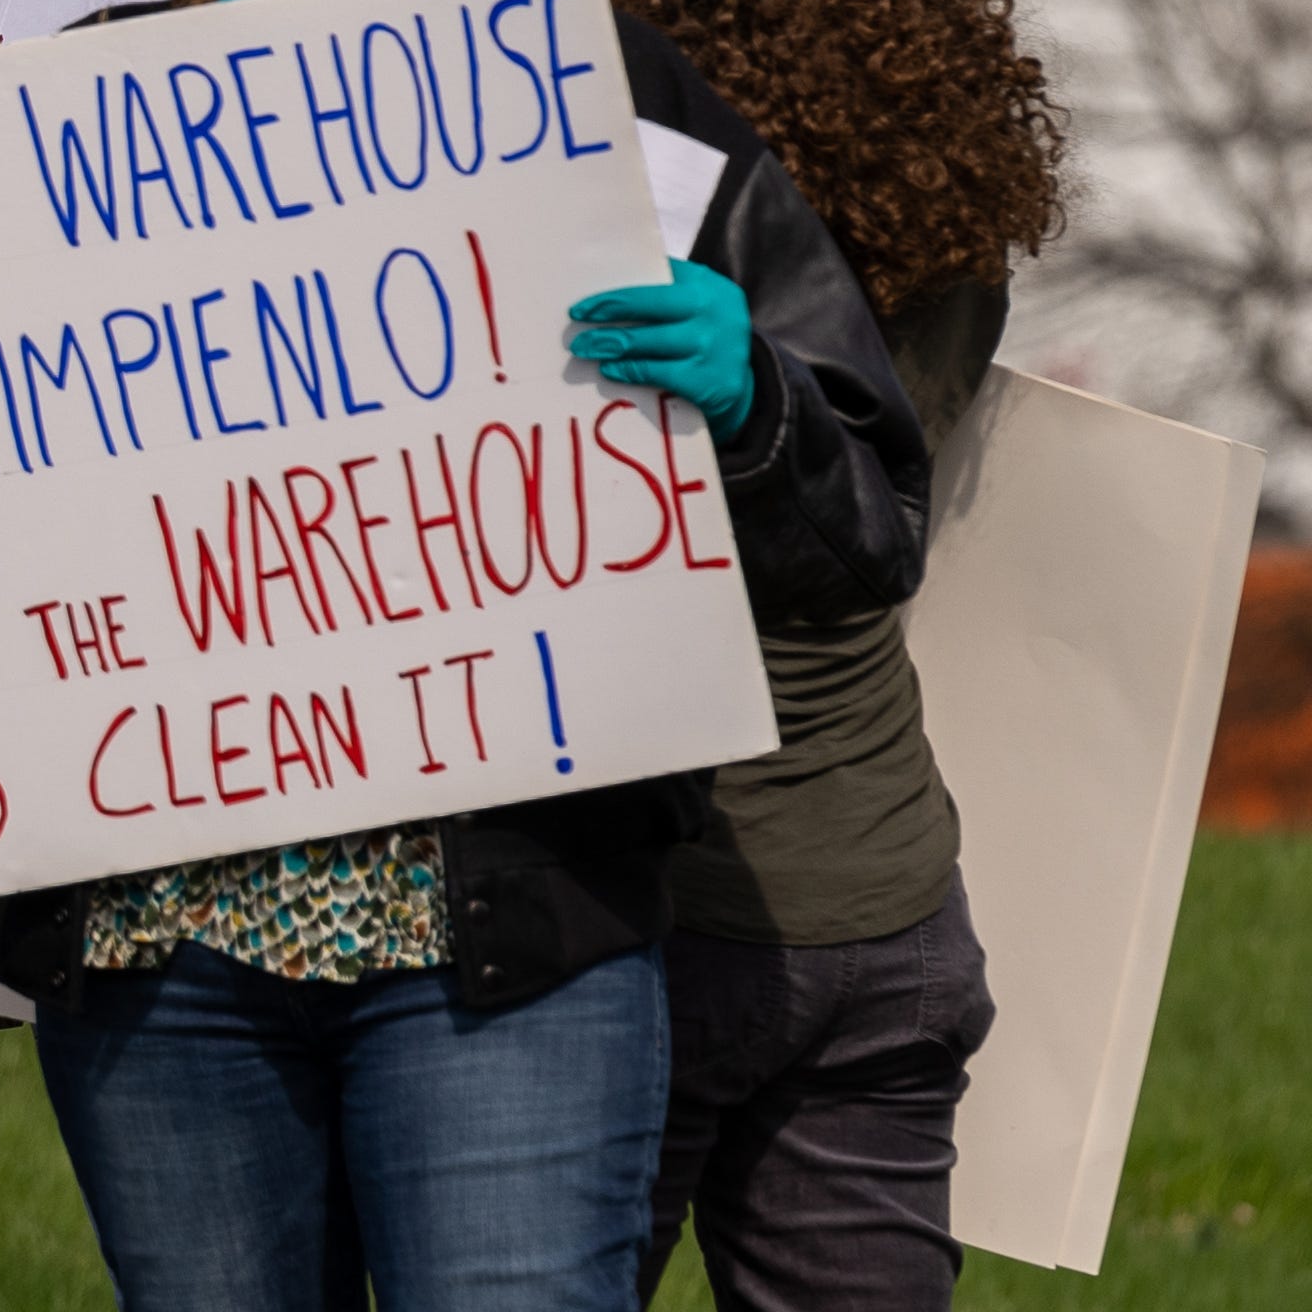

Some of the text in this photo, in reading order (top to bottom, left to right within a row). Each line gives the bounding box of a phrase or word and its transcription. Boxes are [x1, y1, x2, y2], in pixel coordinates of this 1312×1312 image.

[23, 595, 147, 680] THE
[152, 396, 732, 653] WAREHOUSE
[88, 685, 368, 818] CLEAN
